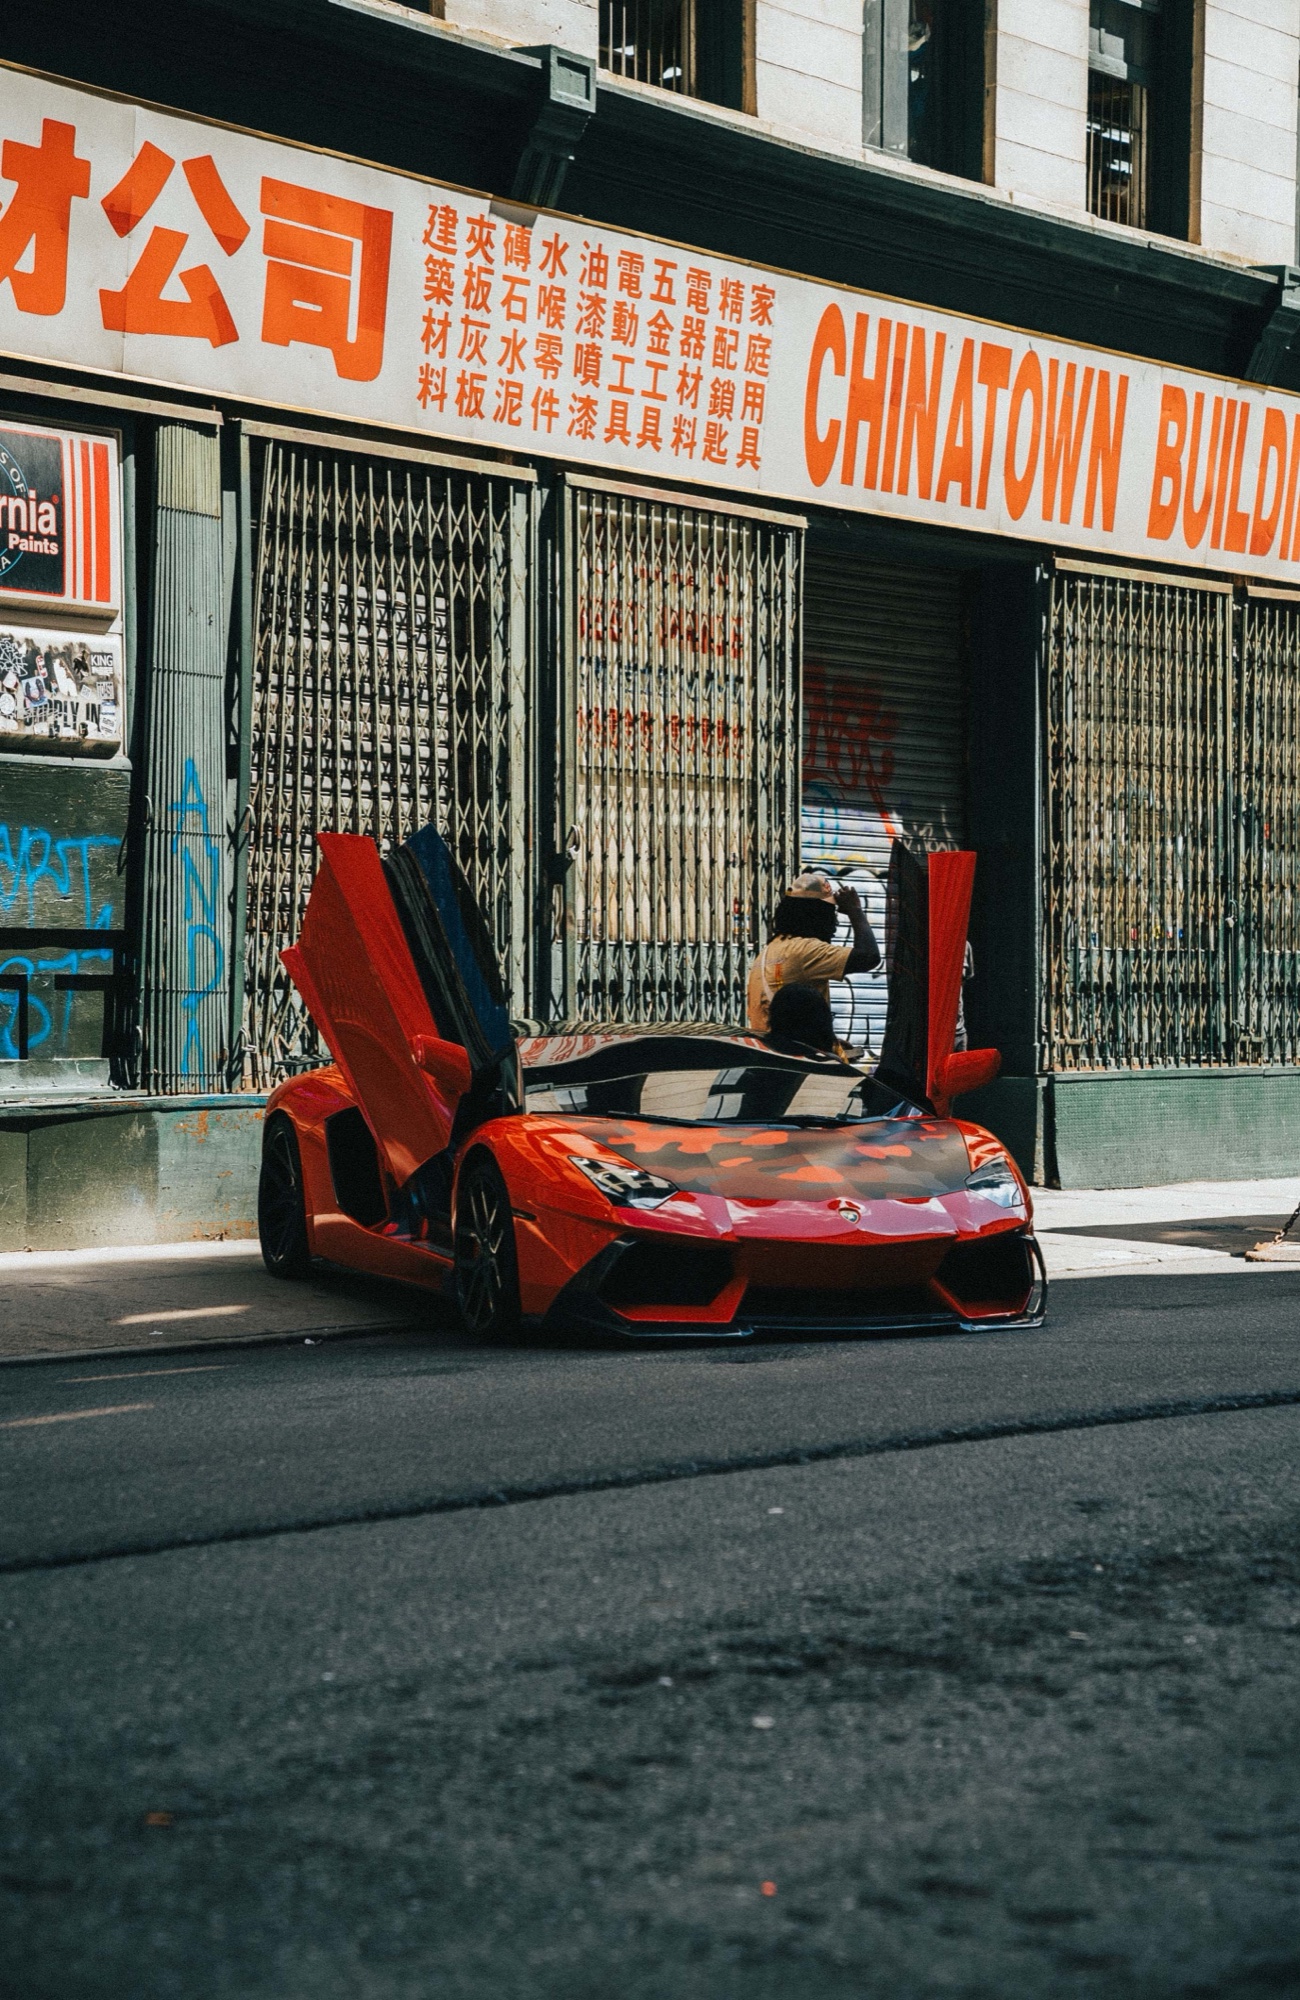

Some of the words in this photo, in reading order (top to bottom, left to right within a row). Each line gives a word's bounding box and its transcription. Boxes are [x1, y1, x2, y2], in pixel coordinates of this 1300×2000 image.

[805, 303, 1129, 533] CHINATOWN
[8, 533, 59, 555] Paints
[91, 654, 114, 667] KING
